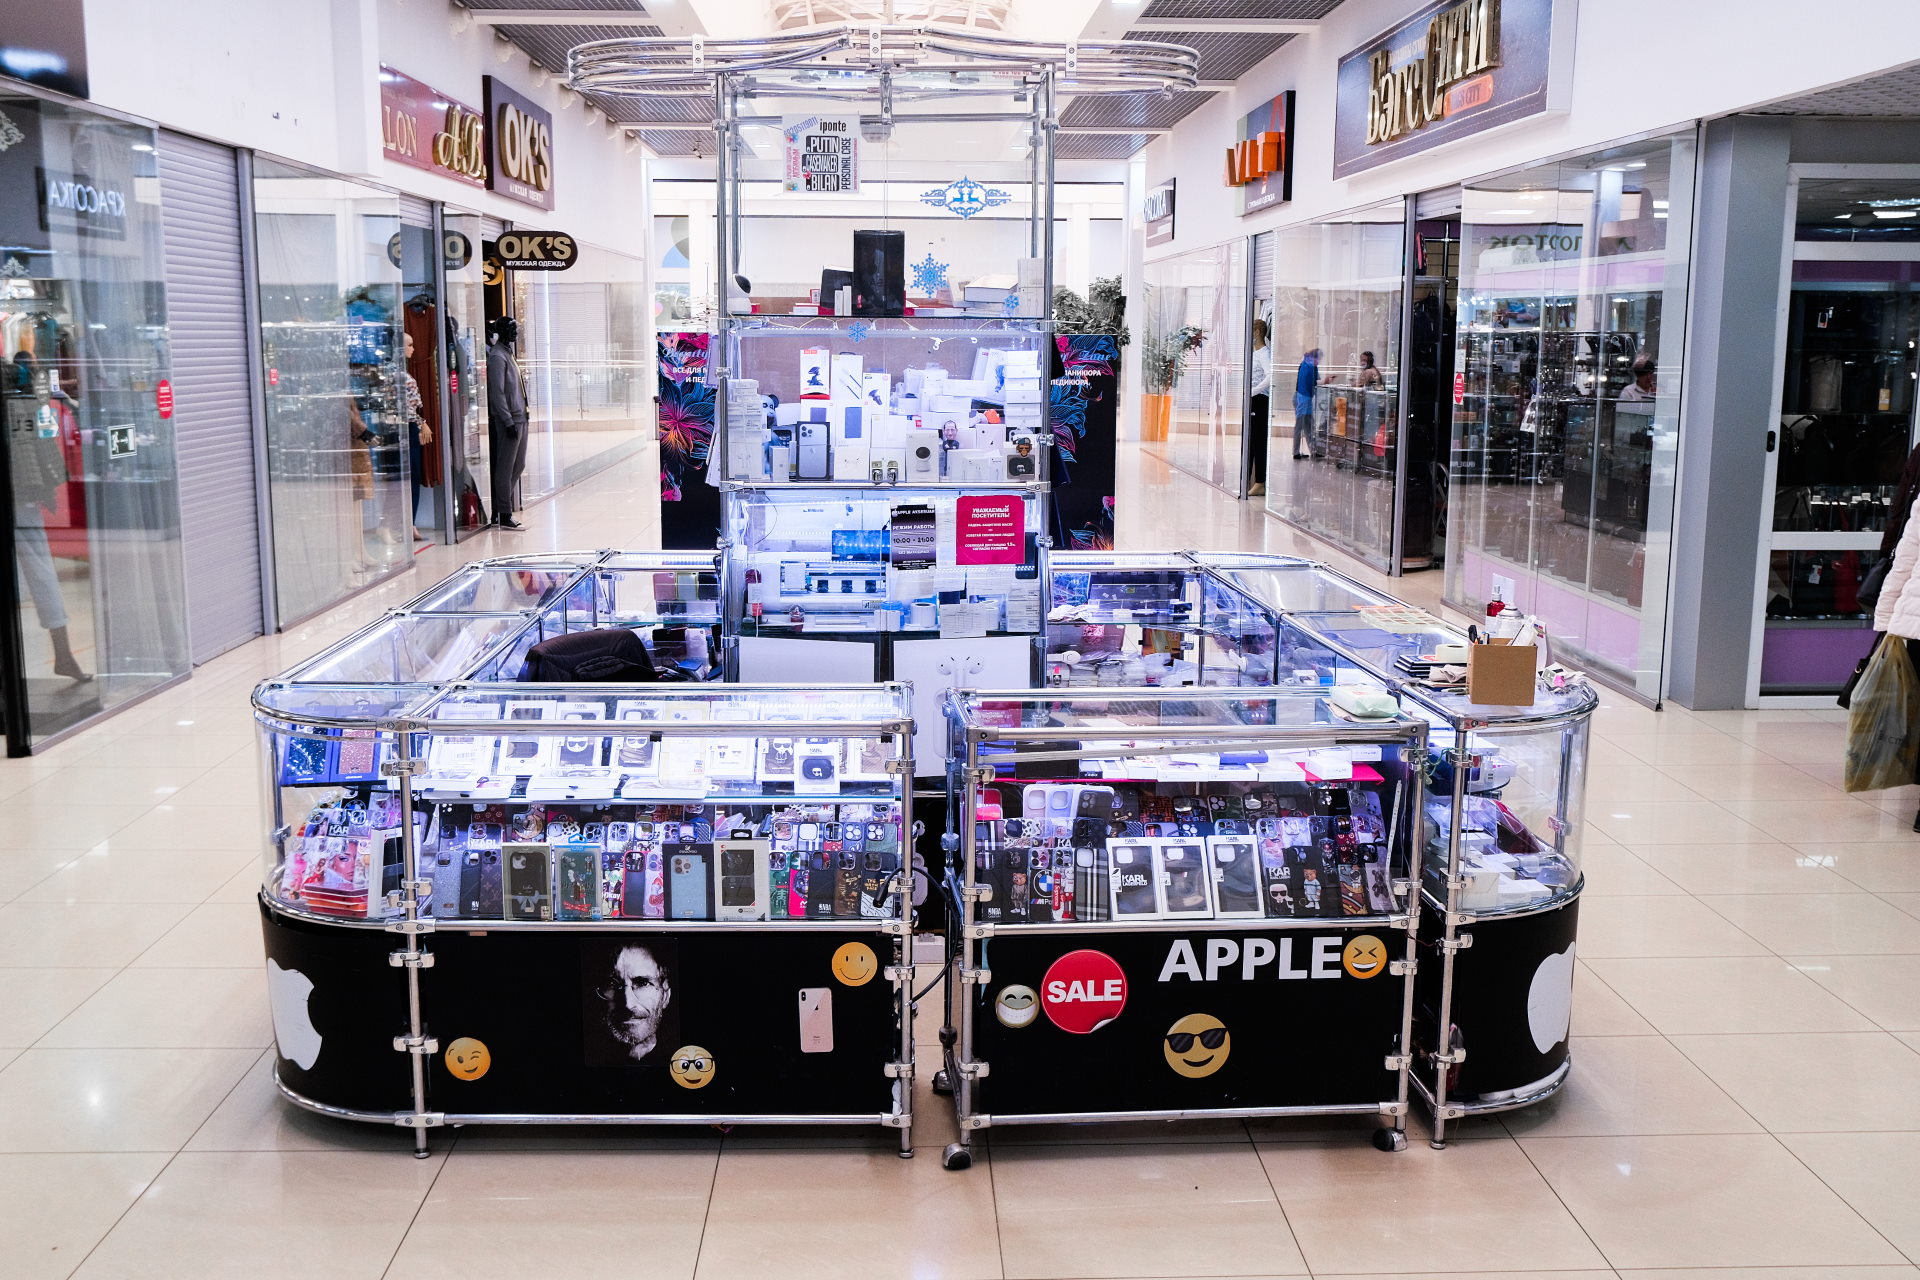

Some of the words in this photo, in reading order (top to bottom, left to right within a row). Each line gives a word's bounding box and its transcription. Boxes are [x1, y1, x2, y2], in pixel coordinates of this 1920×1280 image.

[820, 118, 847, 134] iponte
[810, 136, 839, 153] PUTIN
[841, 137, 851, 155] CASE
[841, 156, 851, 190] PERSONAL
[811, 174, 838, 191] BILAN
[499, 235, 572, 260] OK'S
[972, 505, 1009, 513] УВАЖАЕМЫЙ
[1157, 937, 1342, 982] APPLE
[1047, 980, 1122, 1003] SALE
